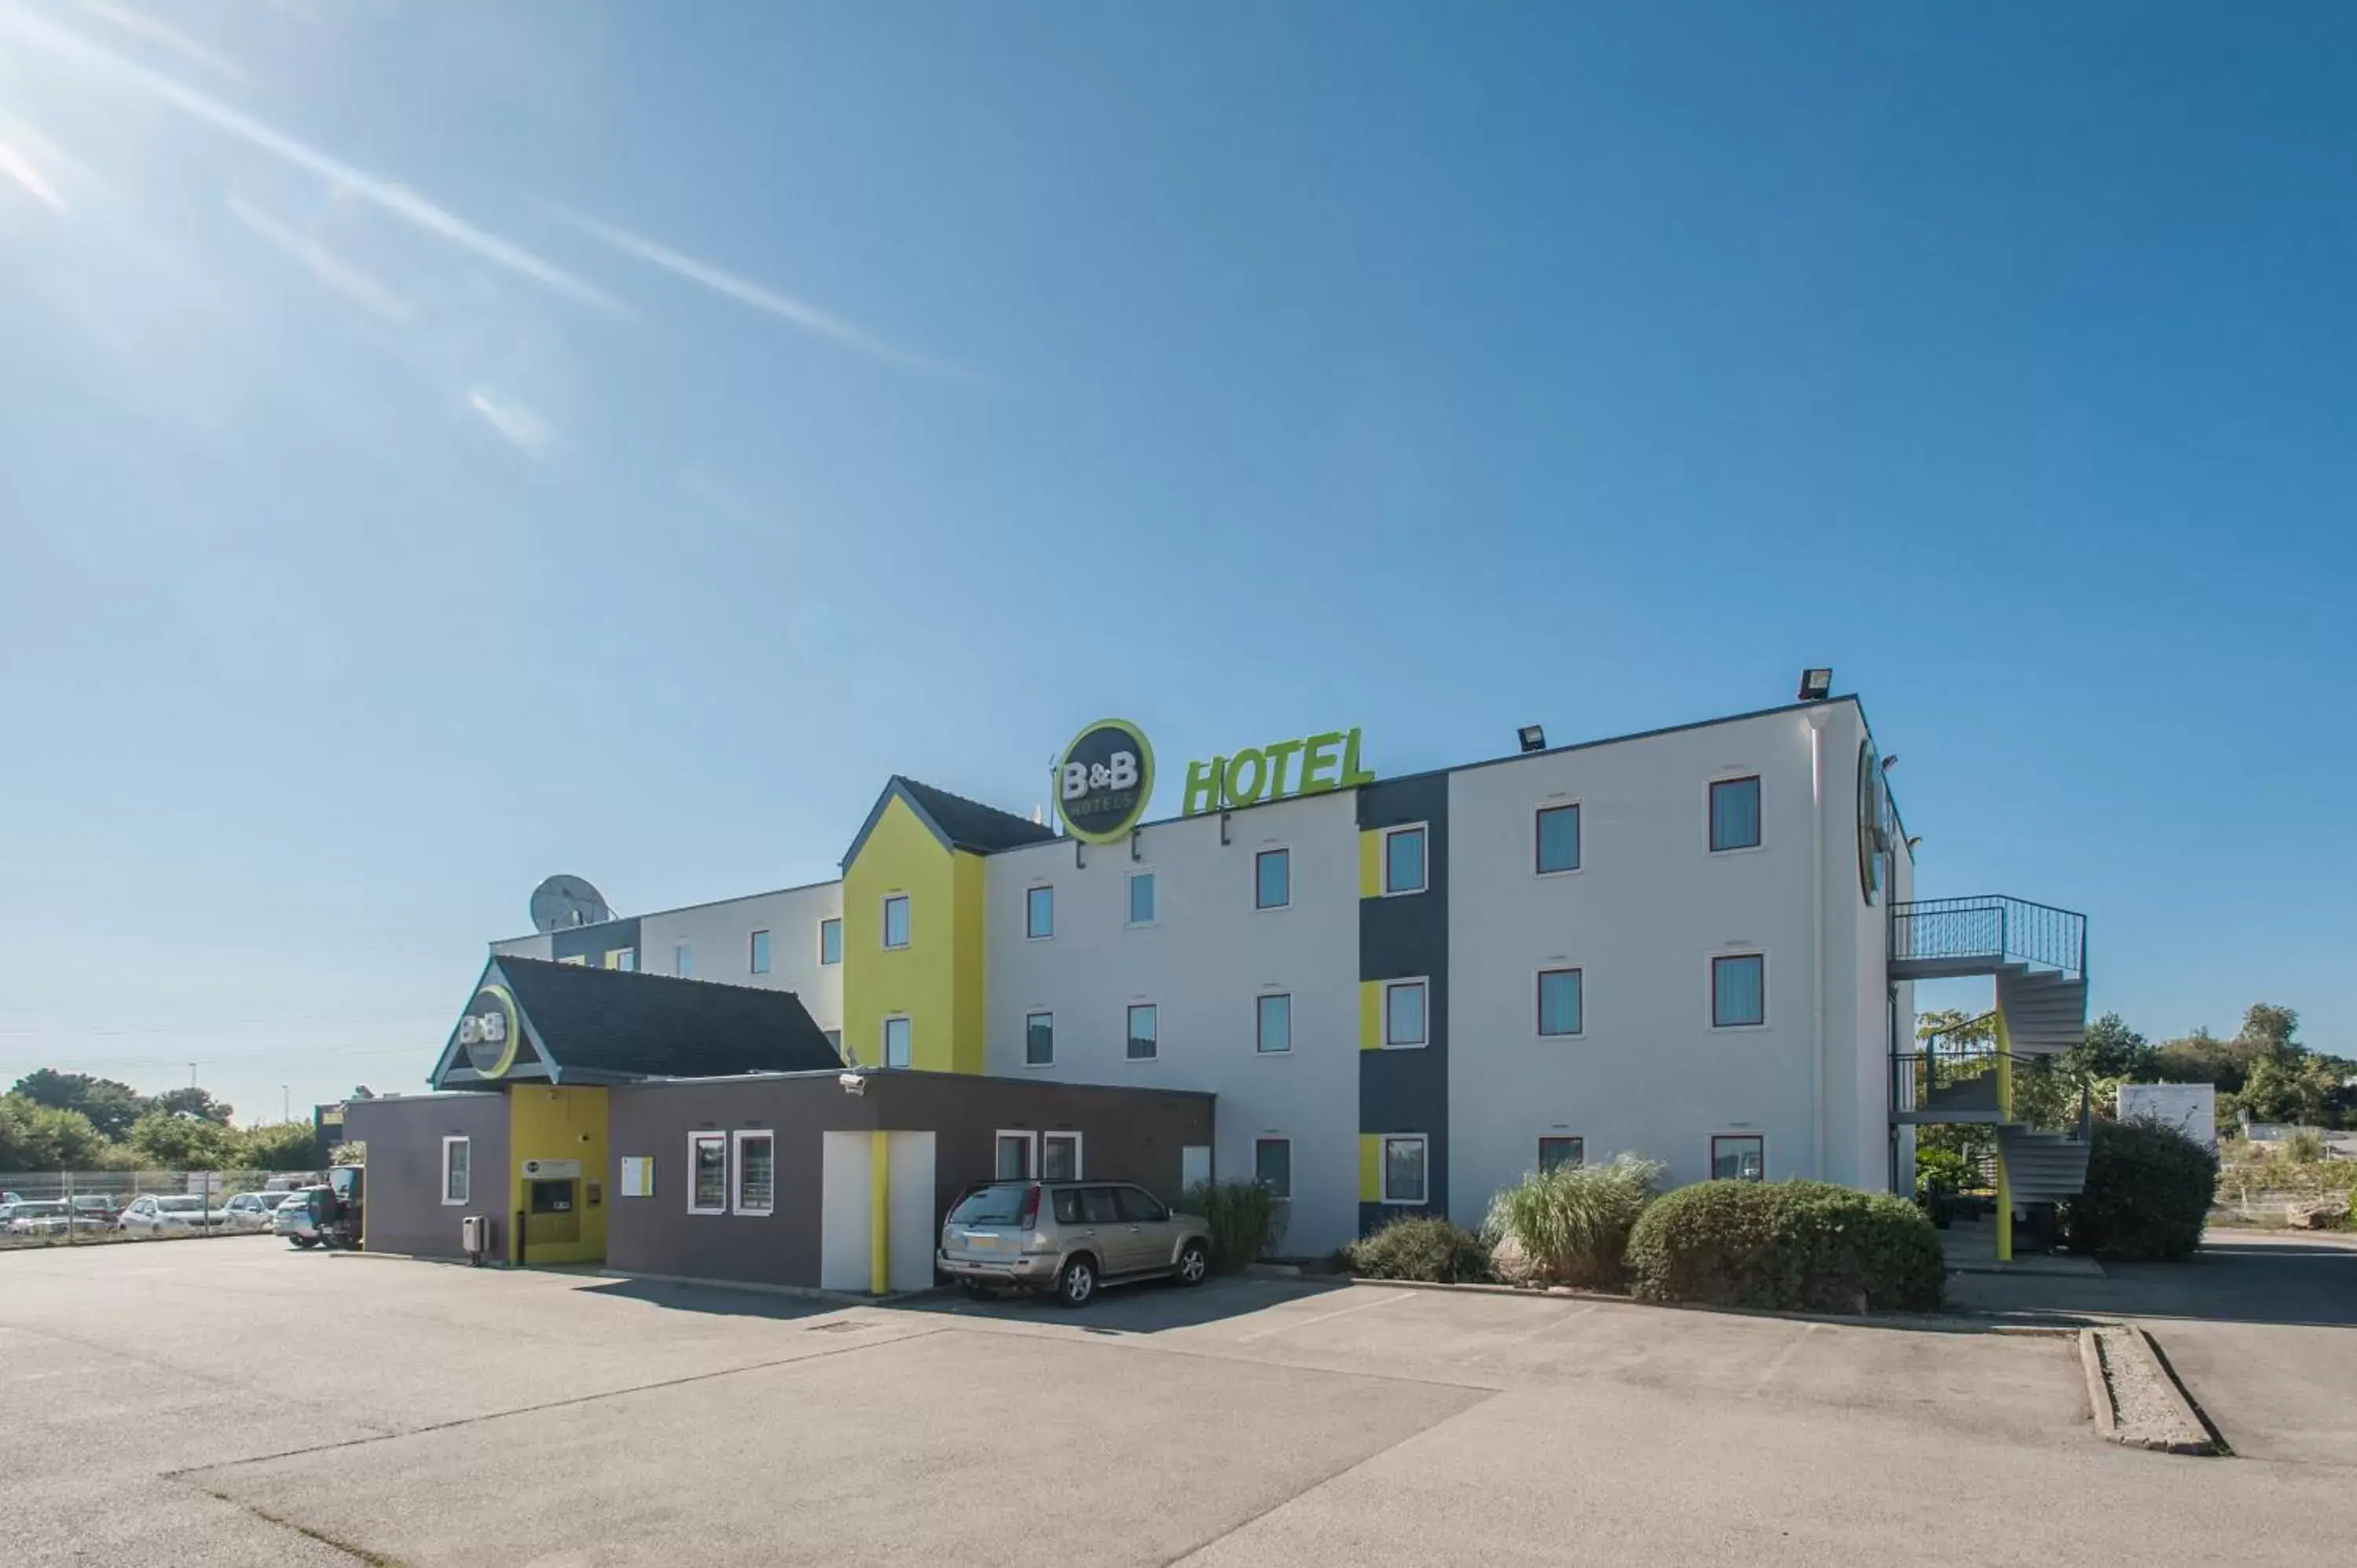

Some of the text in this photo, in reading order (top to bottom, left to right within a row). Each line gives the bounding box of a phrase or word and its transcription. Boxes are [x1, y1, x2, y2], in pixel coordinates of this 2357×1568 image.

[1062, 751, 1138, 800] B&B
[1182, 727, 1376, 817] HOTEL
[1070, 792, 1135, 815] HOTELS
